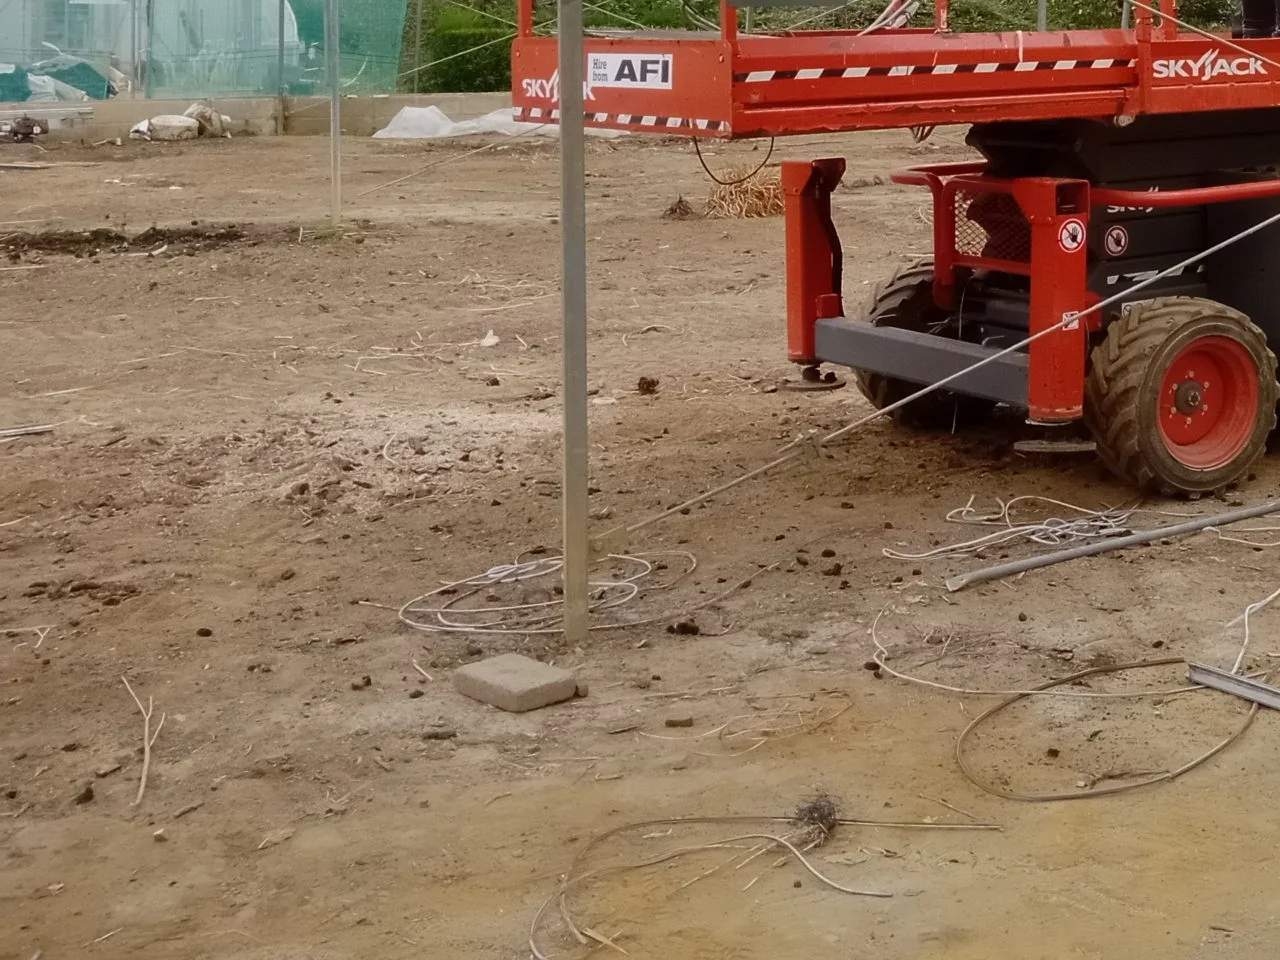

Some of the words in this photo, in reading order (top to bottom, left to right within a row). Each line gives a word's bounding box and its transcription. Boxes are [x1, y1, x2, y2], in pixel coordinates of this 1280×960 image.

[592, 58, 607, 70] Hire
[614, 59, 669, 83] AFI
[1152, 48, 1268, 81] SKYJACK
[522, 68, 596, 103] SKYJK
